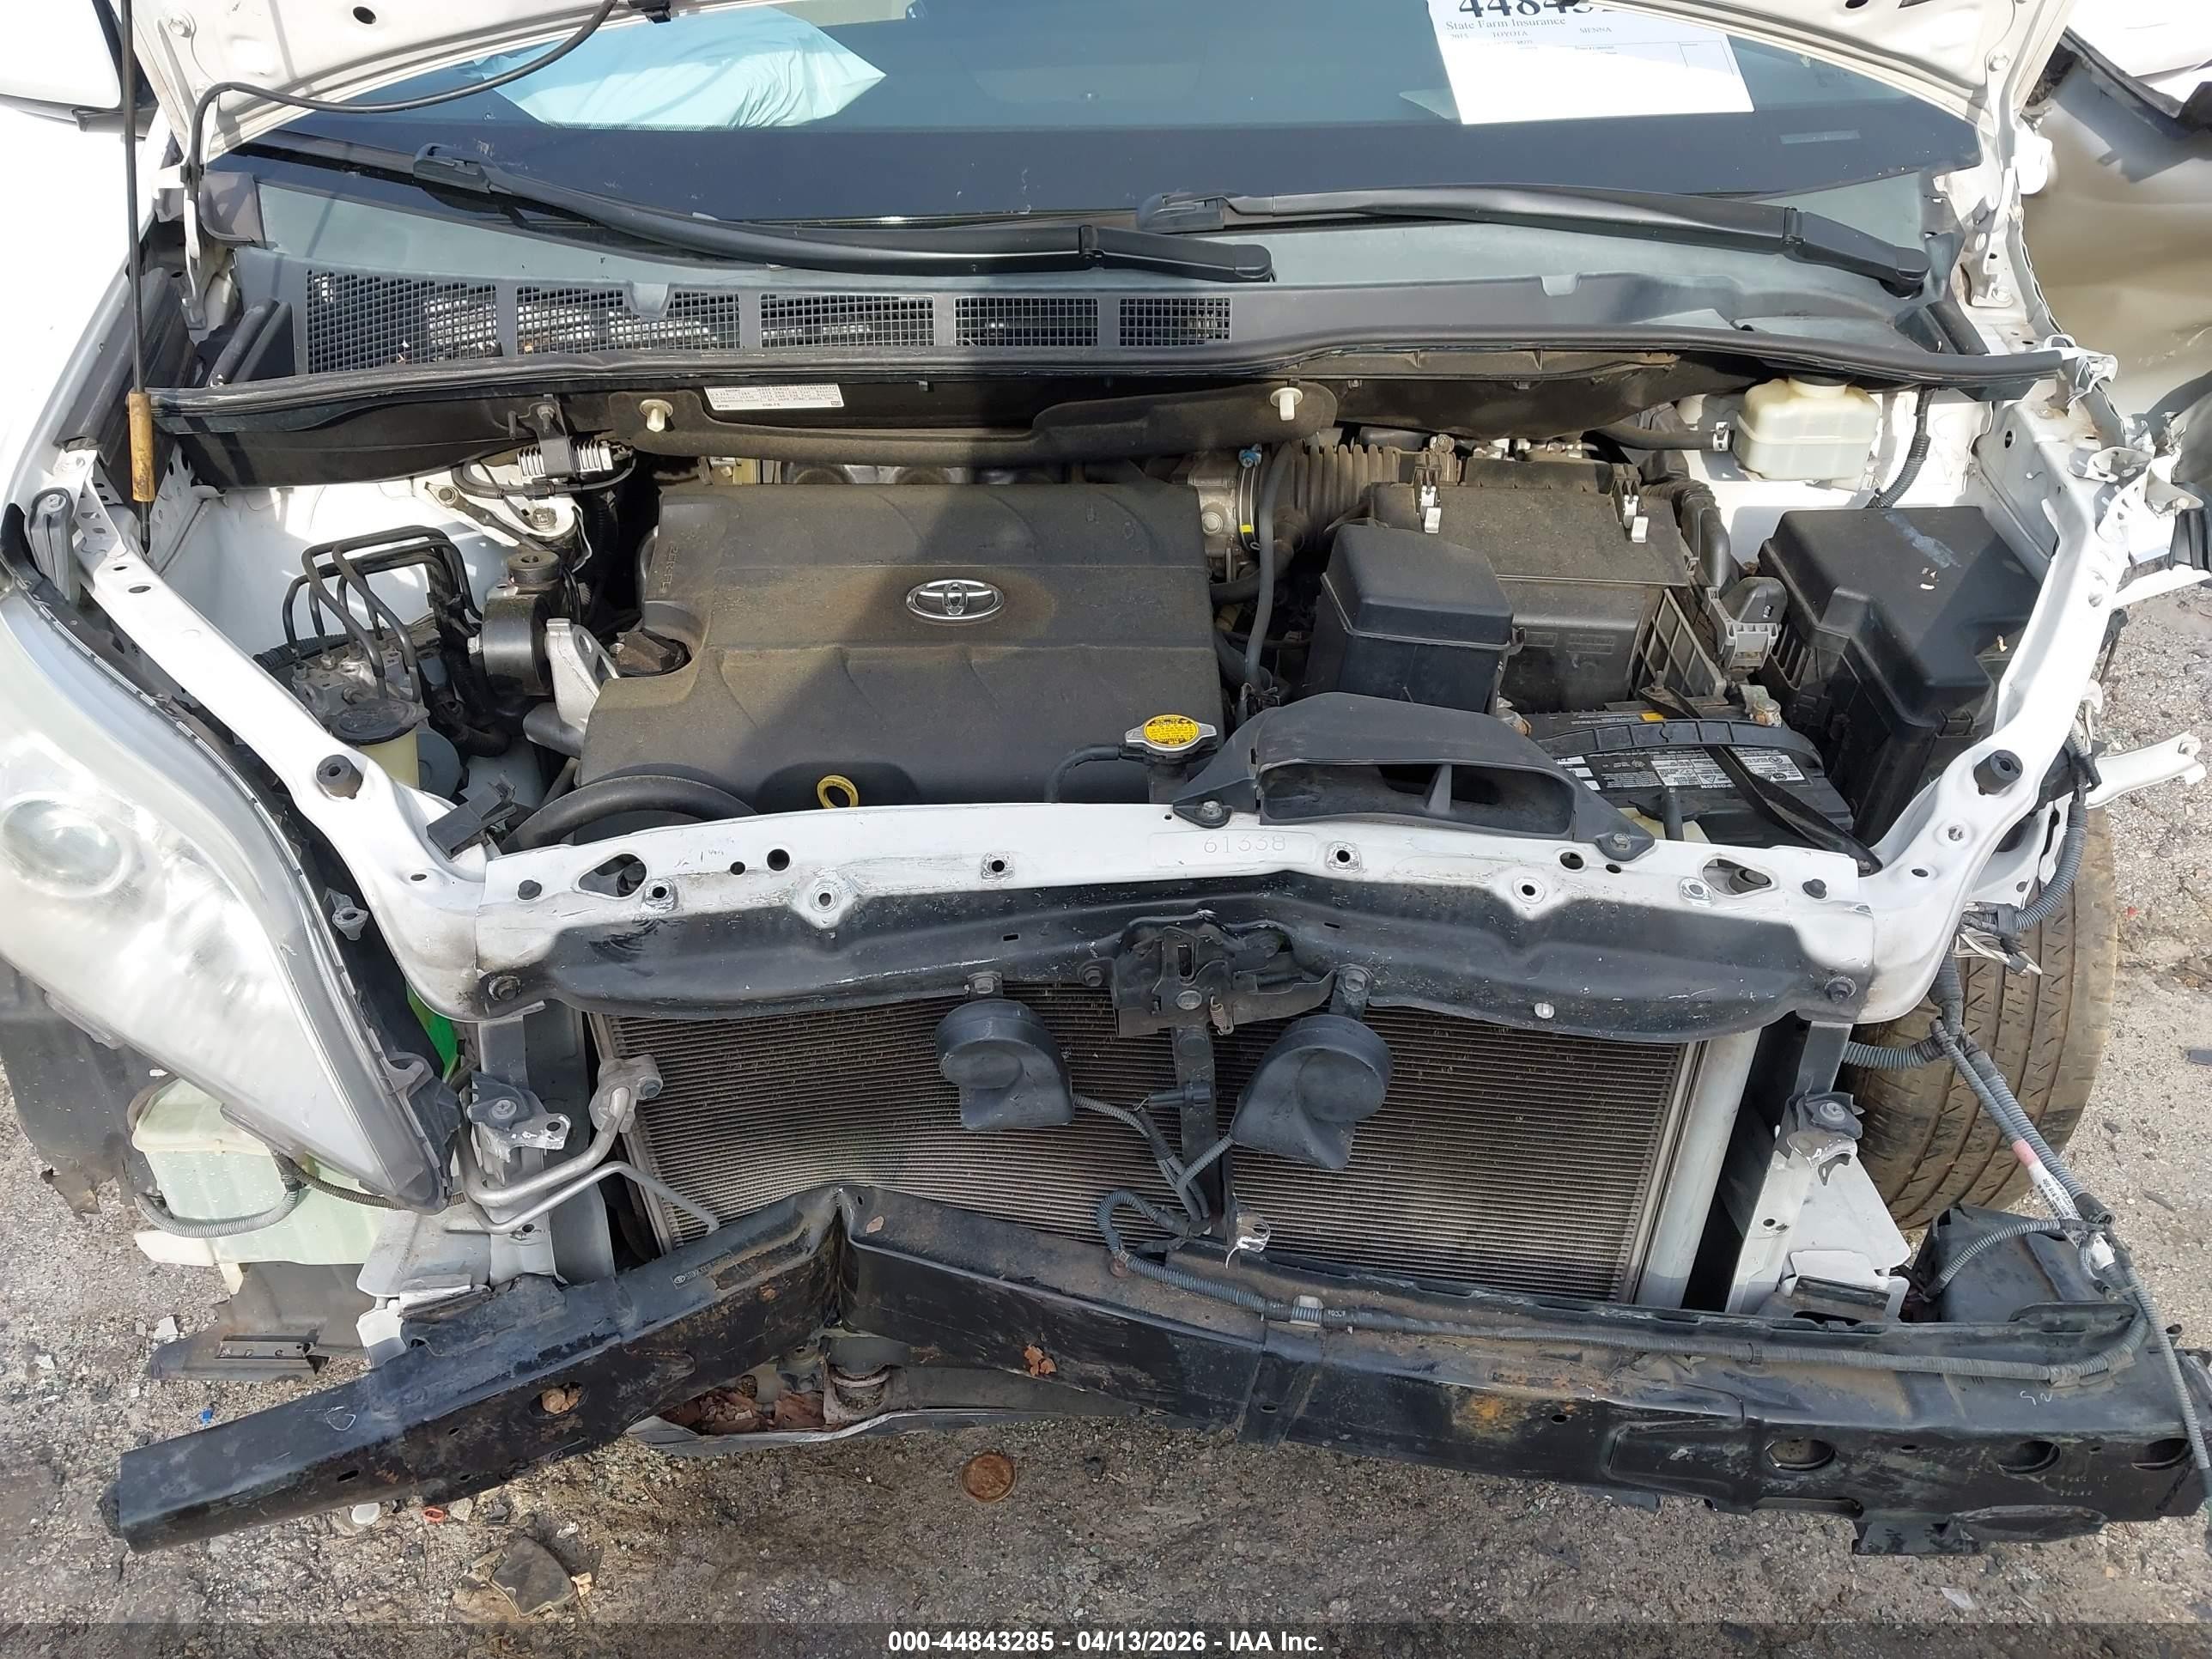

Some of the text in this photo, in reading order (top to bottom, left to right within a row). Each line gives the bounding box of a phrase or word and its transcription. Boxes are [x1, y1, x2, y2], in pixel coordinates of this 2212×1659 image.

[1445, 17, 1567, 30] State Farm Insurance
[1204, 835, 1286, 854] 61338
